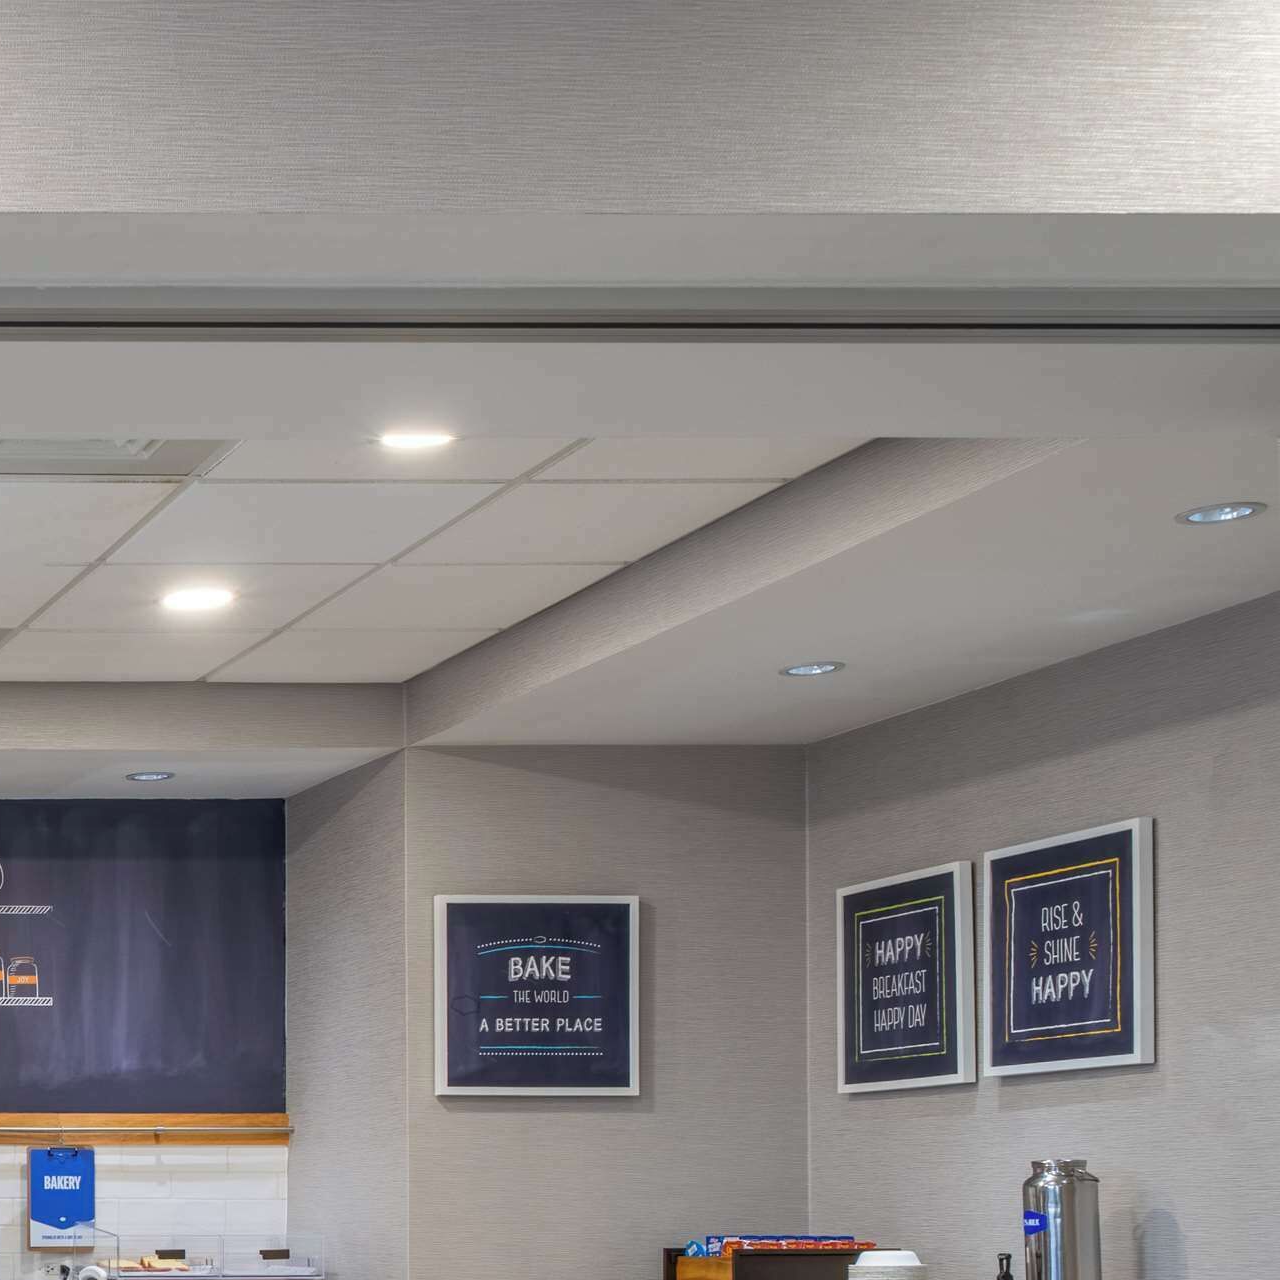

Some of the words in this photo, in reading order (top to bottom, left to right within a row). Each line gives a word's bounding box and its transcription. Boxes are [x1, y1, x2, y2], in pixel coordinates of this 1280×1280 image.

[1041, 903, 1069, 932] RISE
[1072, 901, 1083, 927] &
[875, 933, 924, 967] HAPPY
[1044, 936, 1081, 966] SHINE
[508, 955, 571, 981] BAKE
[513, 990, 531, 1003] THE
[534, 990, 569, 1003] WORLD
[872, 969, 927, 1000] BREAKFAST
[1031, 968, 1094, 1005] HAPPY
[479, 1018, 489, 1032] A
[495, 1018, 550, 1032] BETTER
[556, 1018, 602, 1032] PLACE
[874, 1006, 906, 1032] HAPPY
[908, 1003, 927, 1028] DAY
[43, 1175, 82, 1190] BAKERY
